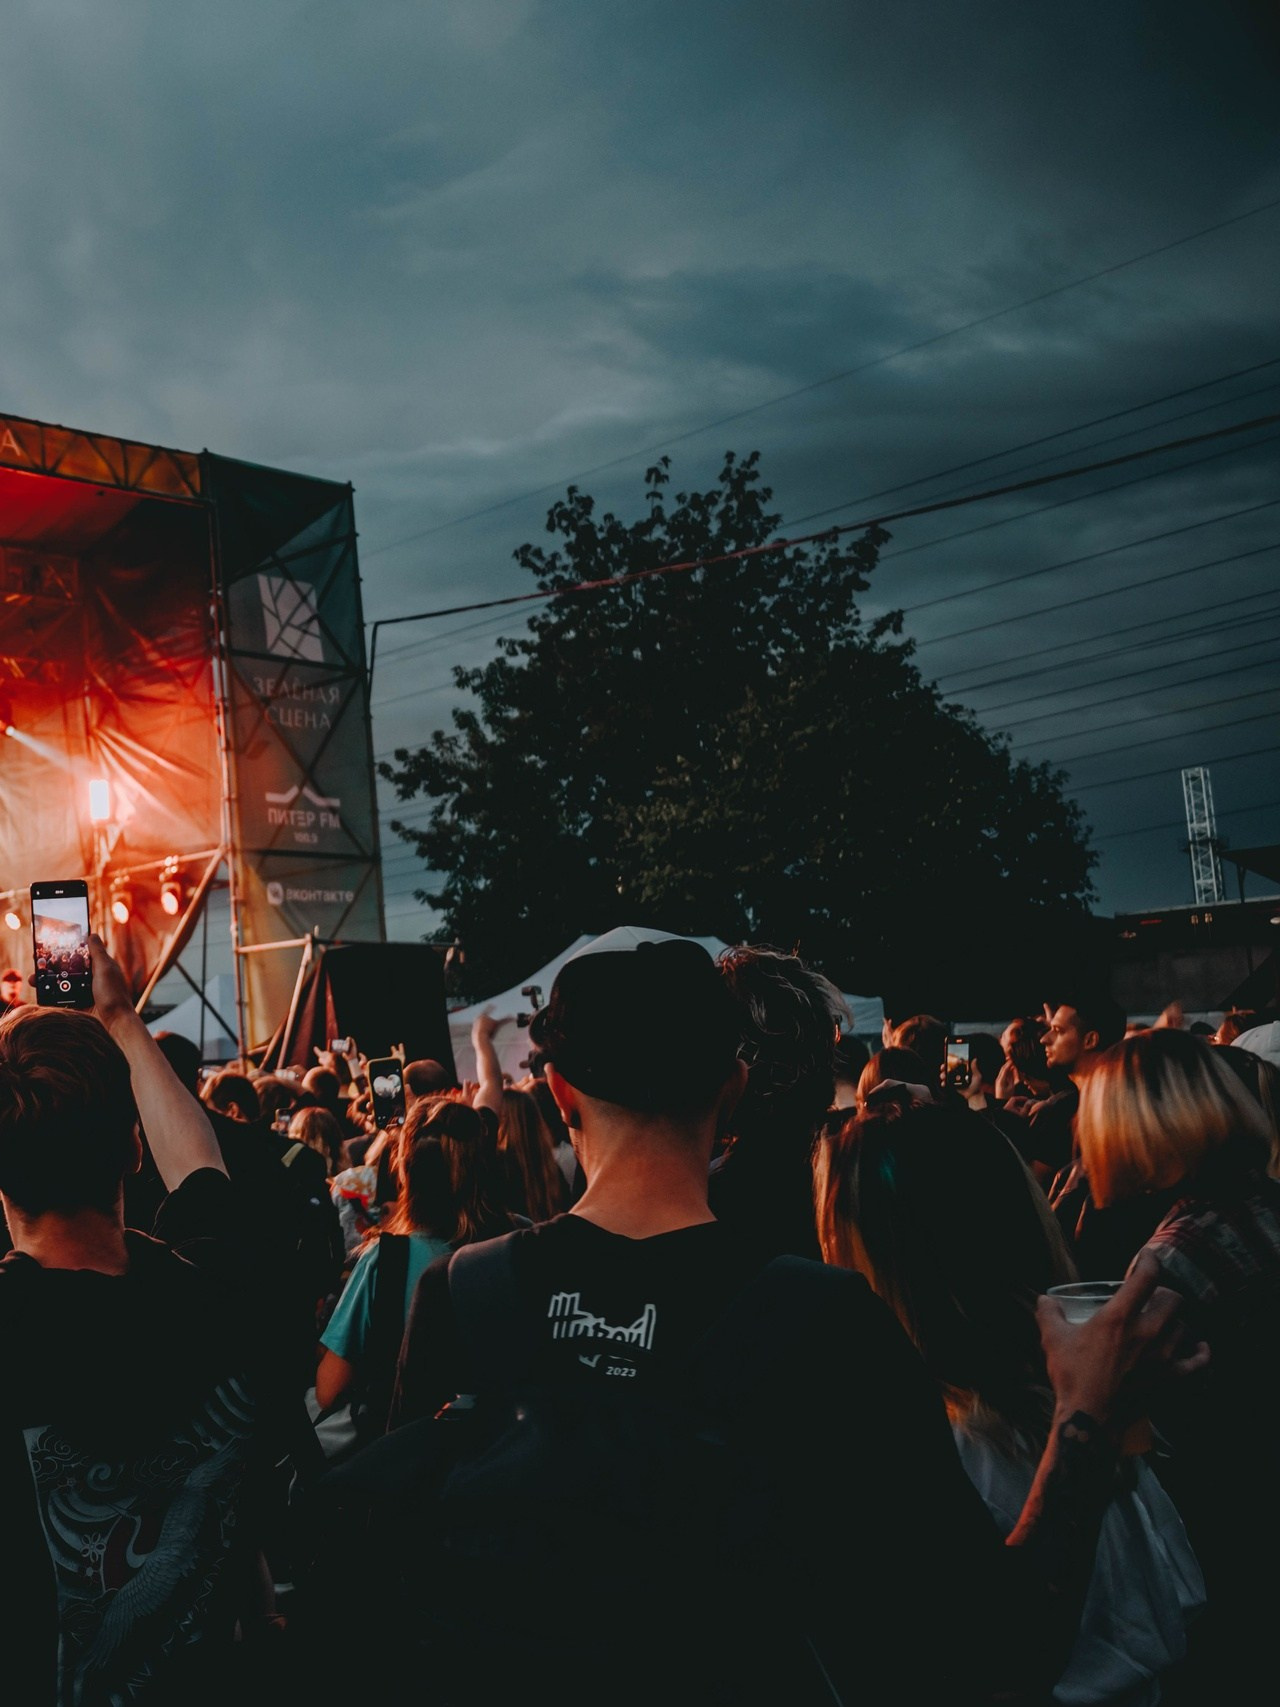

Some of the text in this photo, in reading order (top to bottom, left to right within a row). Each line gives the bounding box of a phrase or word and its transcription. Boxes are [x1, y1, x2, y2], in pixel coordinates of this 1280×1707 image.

[264, 705, 331, 730] СЦЕНА
[268, 807, 341, 829] ПИТЕР FM
[605, 1366, 637, 1378] 2023
